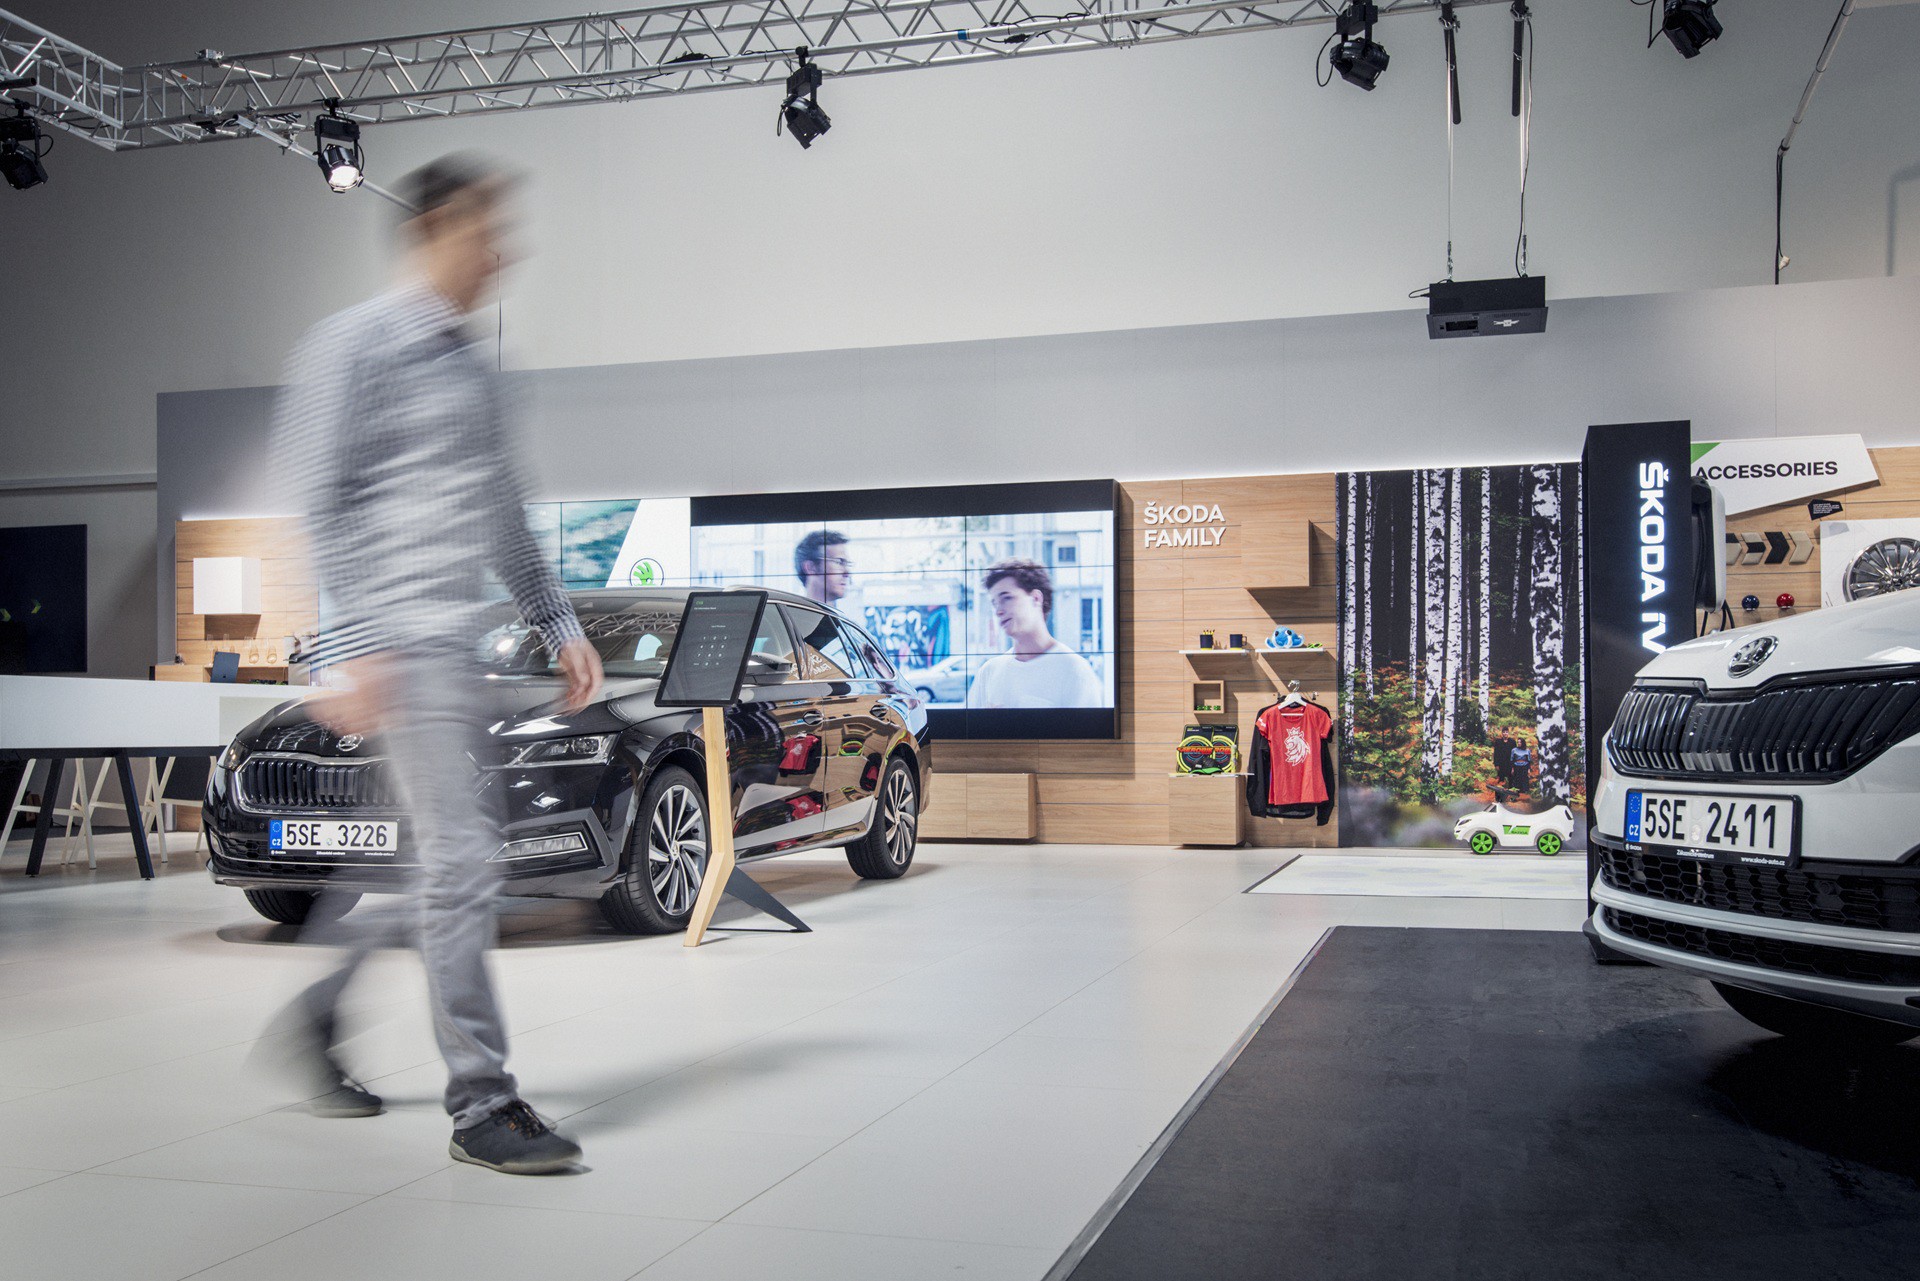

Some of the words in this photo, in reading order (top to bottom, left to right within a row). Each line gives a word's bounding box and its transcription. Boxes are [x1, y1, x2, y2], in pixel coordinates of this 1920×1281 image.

[1696, 461, 1838, 480] ACCESSORIES
[1143, 501, 1226, 525] ŠKODA
[1144, 527, 1227, 549] FAMILY
[1639, 462, 1669, 602] ŠKODA
[1629, 824, 1639, 836] CZ
[1645, 798, 1687, 840] 5SE
[1706, 801, 1776, 849] 2411
[287, 824, 321, 846] 5SE
[338, 824, 388, 847] 3226
